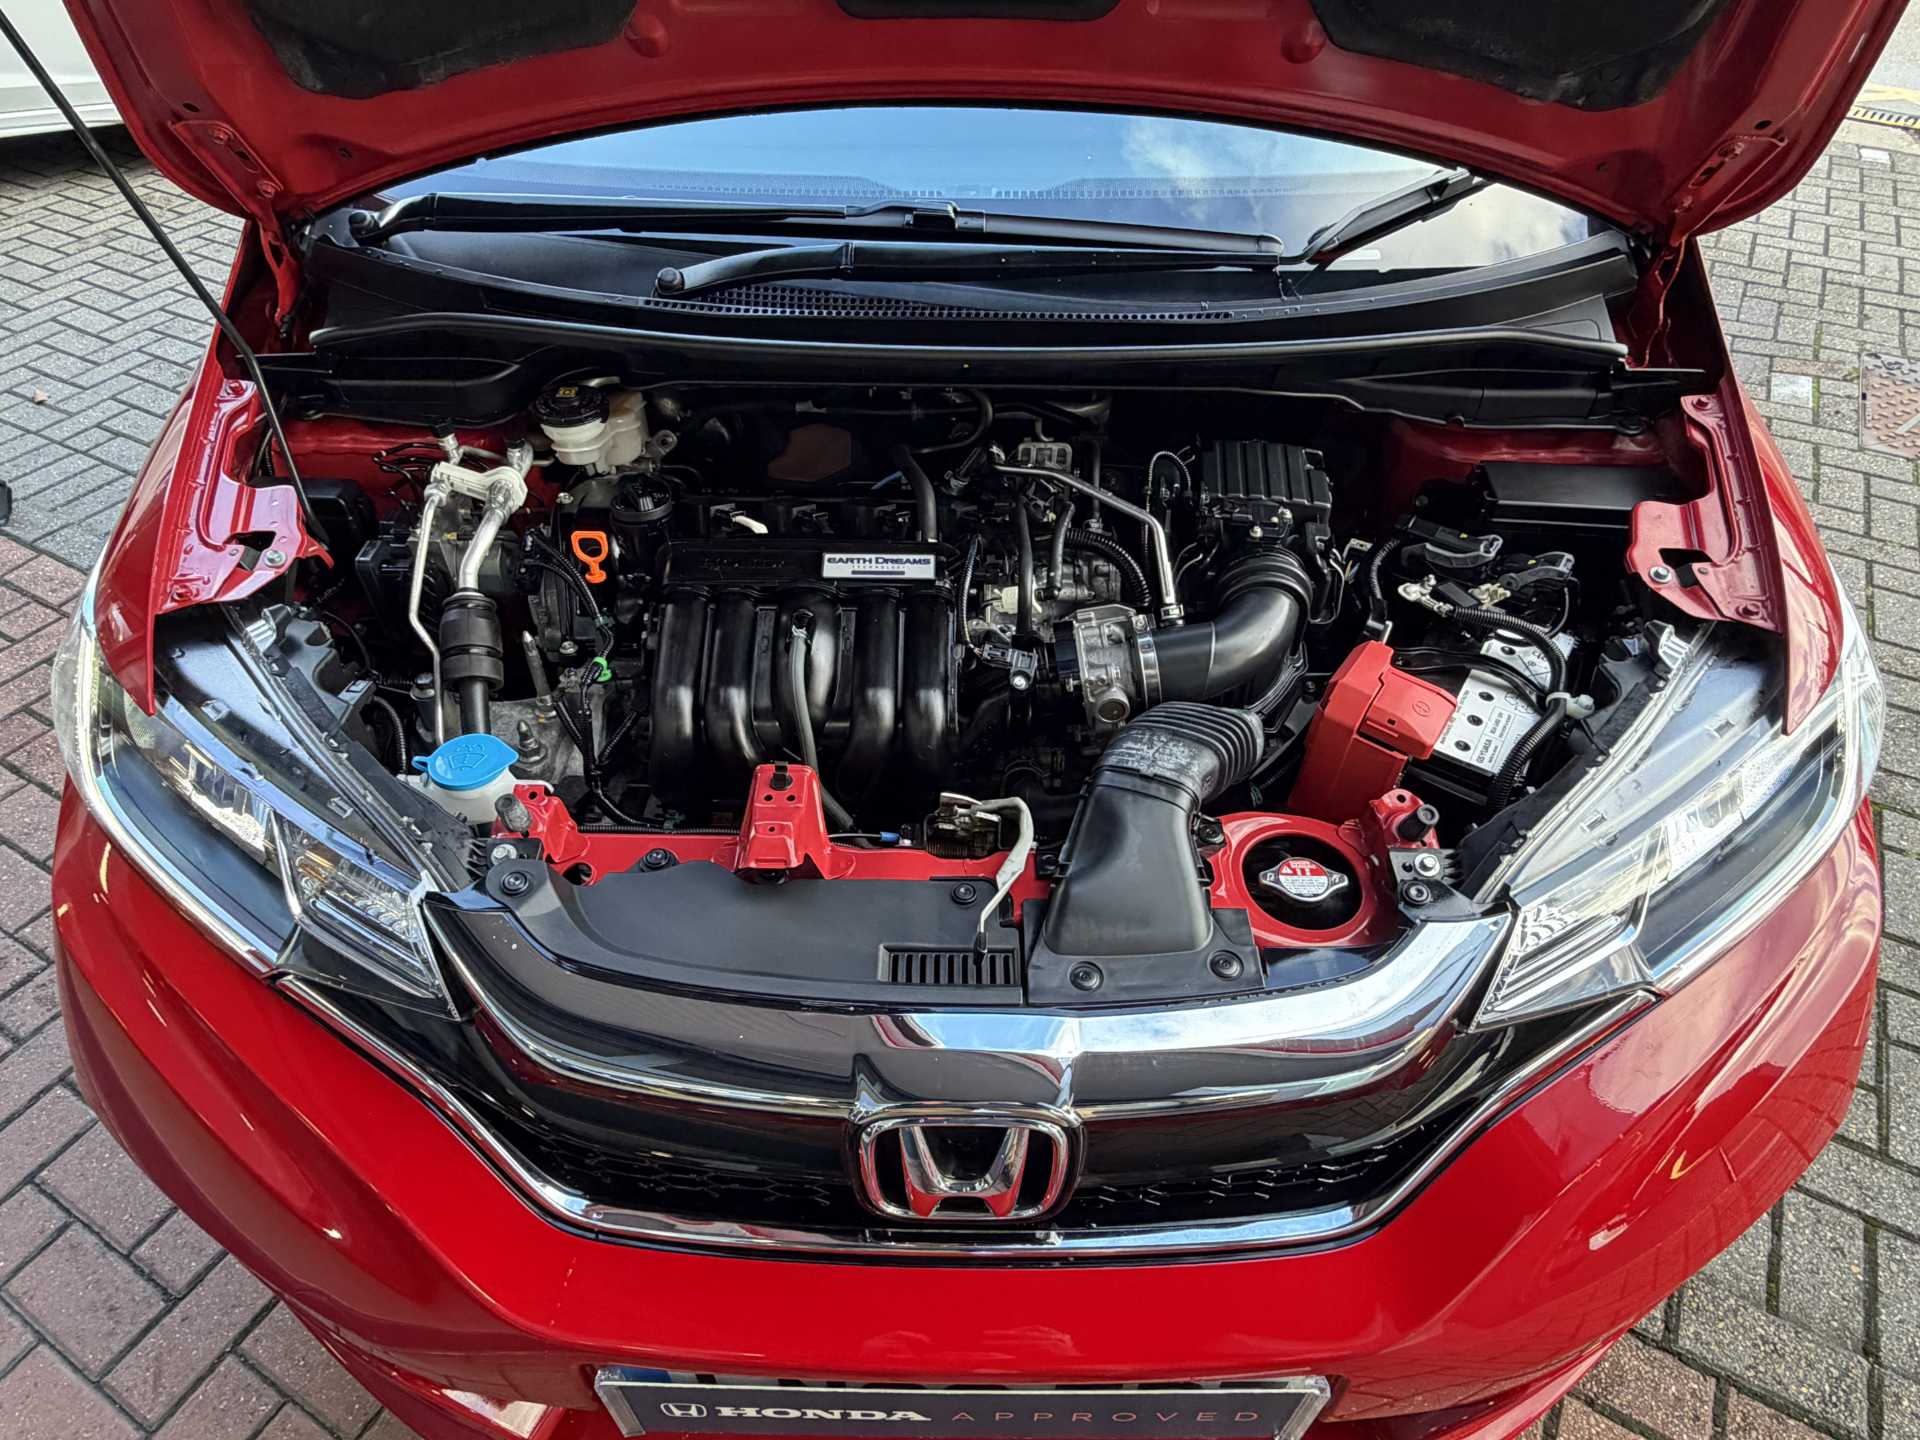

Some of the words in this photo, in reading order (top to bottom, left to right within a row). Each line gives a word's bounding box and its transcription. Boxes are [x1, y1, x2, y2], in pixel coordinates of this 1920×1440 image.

[827, 557, 873, 565] EARTH
[875, 556, 931, 566] DREAMS
[715, 1406, 932, 1421] HONDA
[952, 1411, 1259, 1423] APPROVED
